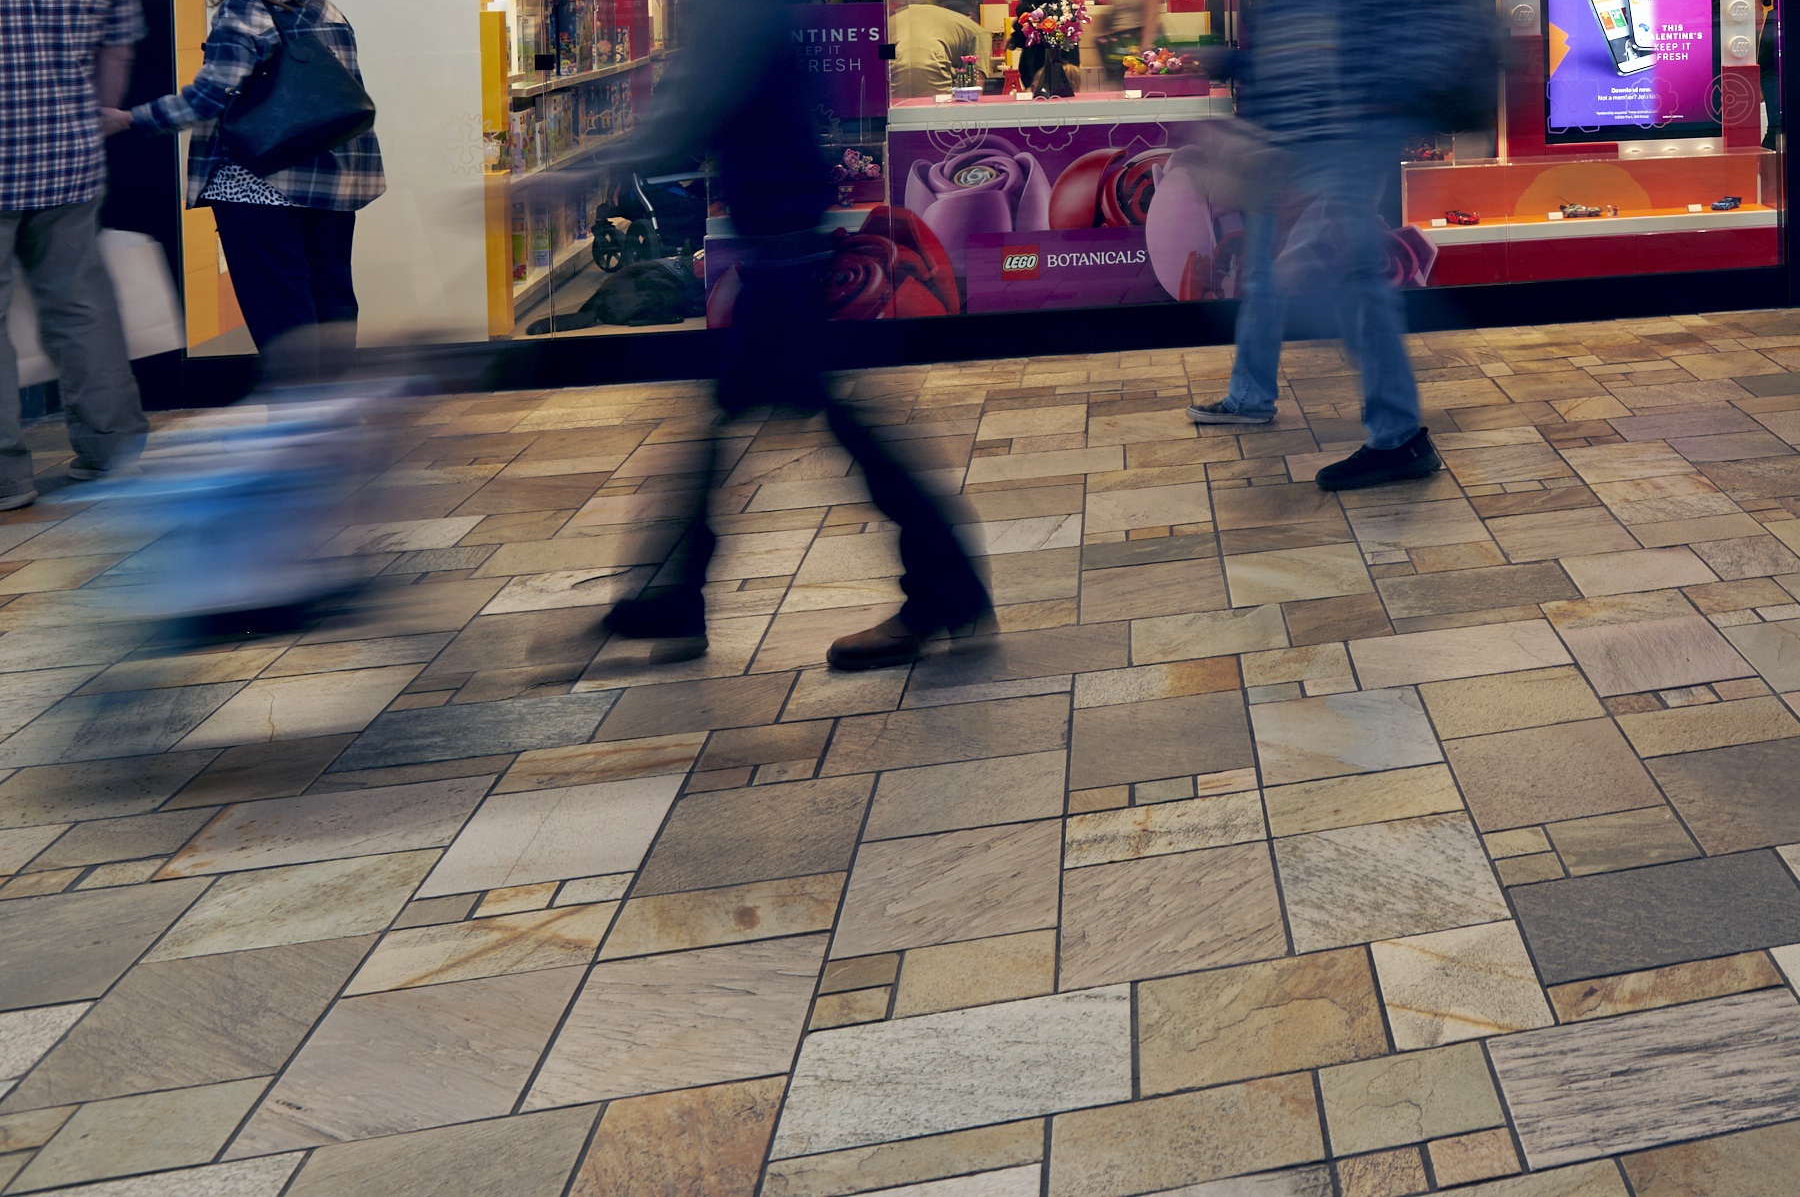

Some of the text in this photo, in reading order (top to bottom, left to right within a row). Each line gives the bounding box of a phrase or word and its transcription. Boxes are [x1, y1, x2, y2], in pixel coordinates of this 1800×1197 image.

[1650, 32, 1703, 41] ALENTINE'S
[828, 45, 841, 55] IT
[1682, 43, 1691, 51] IT
[1656, 52, 1689, 61] FRESH
[1003, 249, 1146, 271] LEGO BOTANICALS
